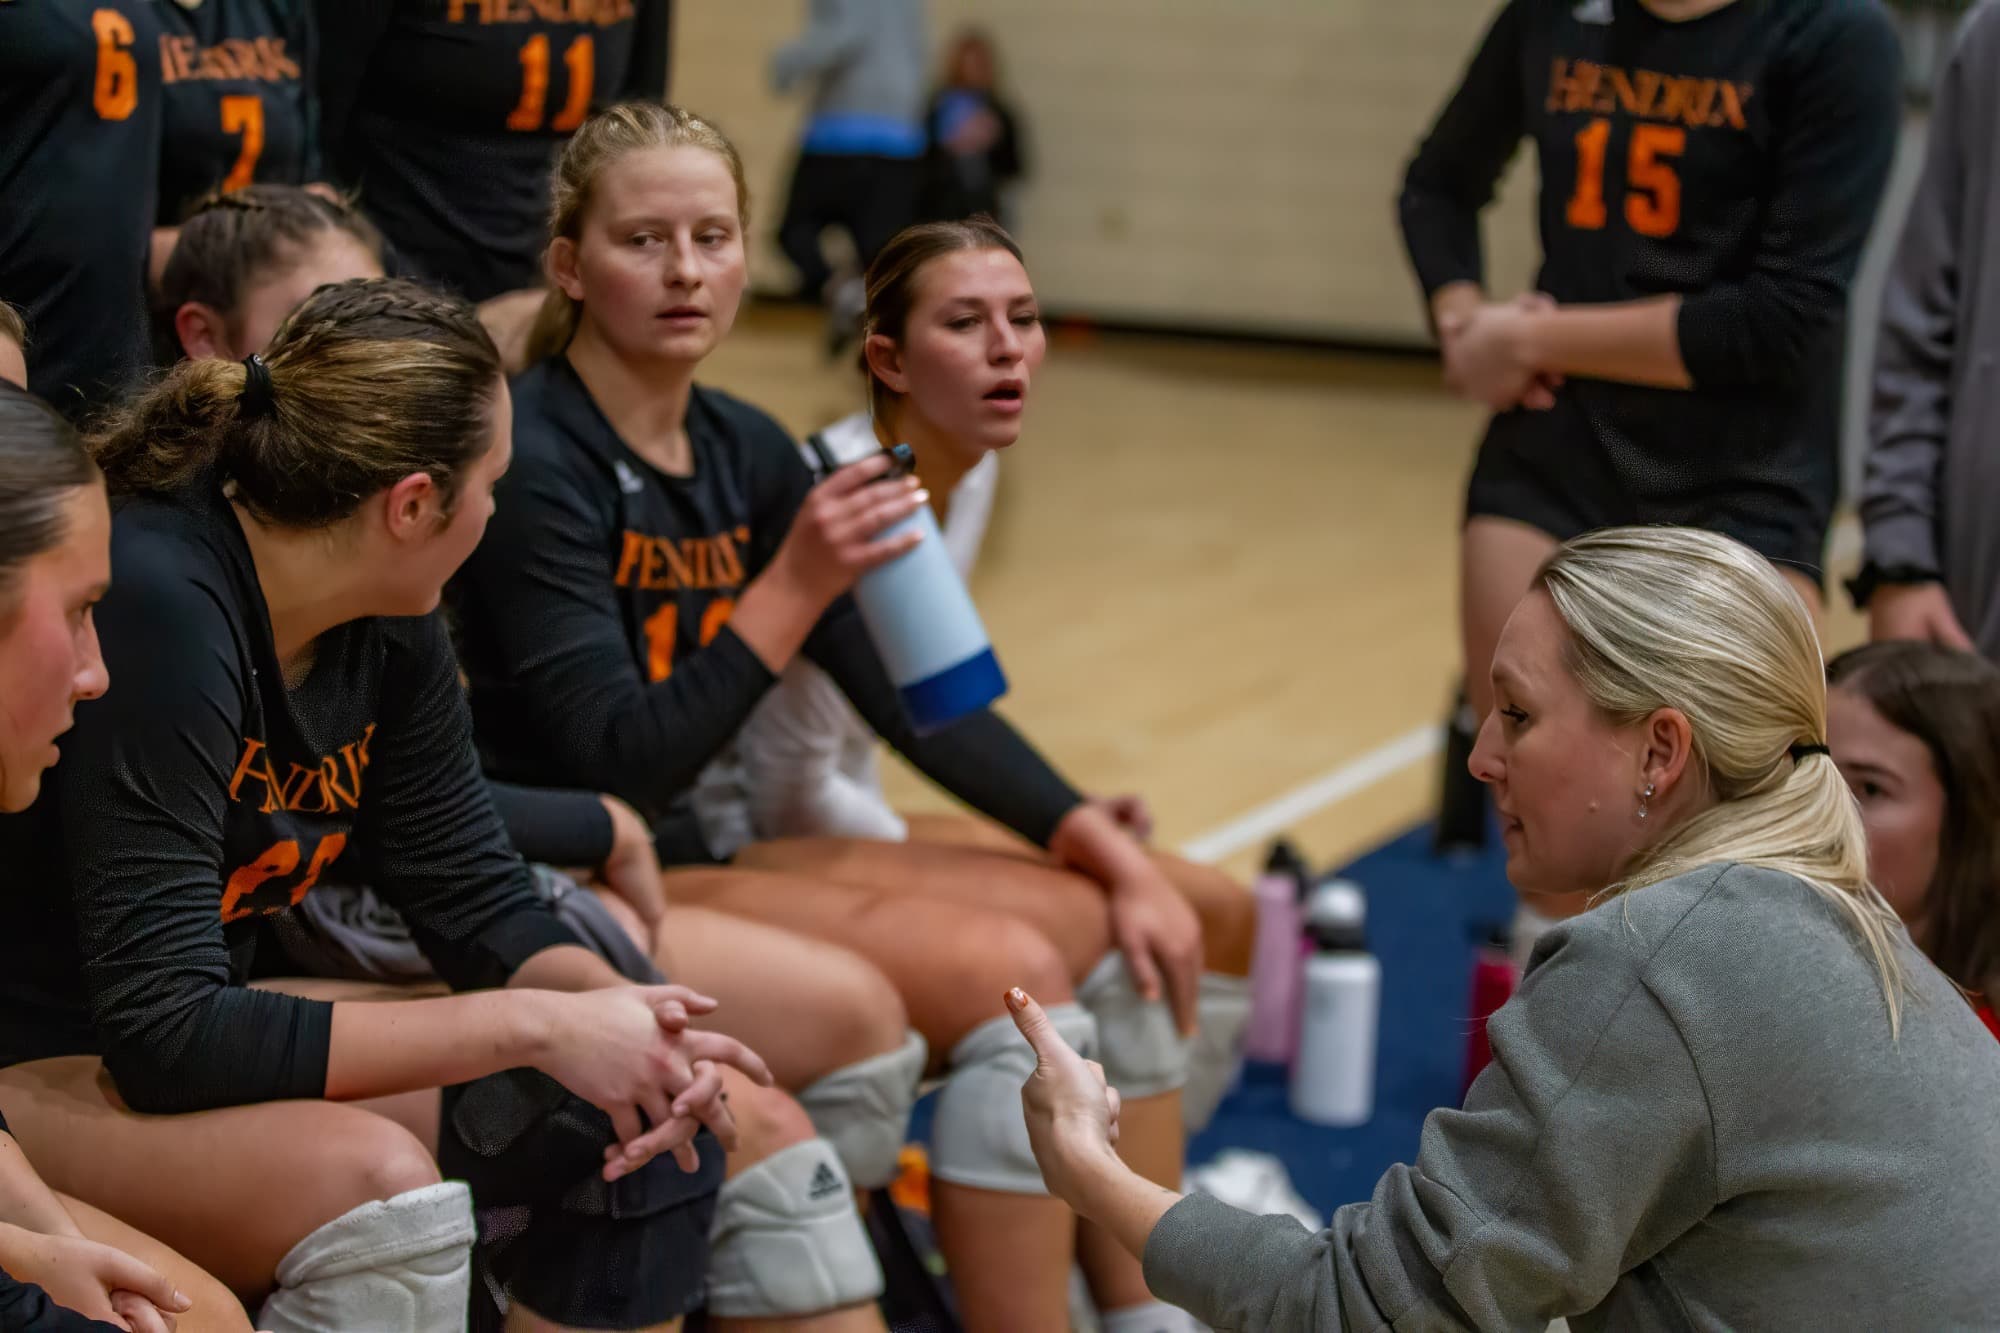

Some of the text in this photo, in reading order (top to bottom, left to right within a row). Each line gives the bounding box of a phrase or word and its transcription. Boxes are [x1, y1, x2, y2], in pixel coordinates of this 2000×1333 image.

[92, 9, 137, 119] 6
[507, 34, 594, 131] 11
[221, 95, 263, 193] 7
[1566, 118, 1685, 237] 15
